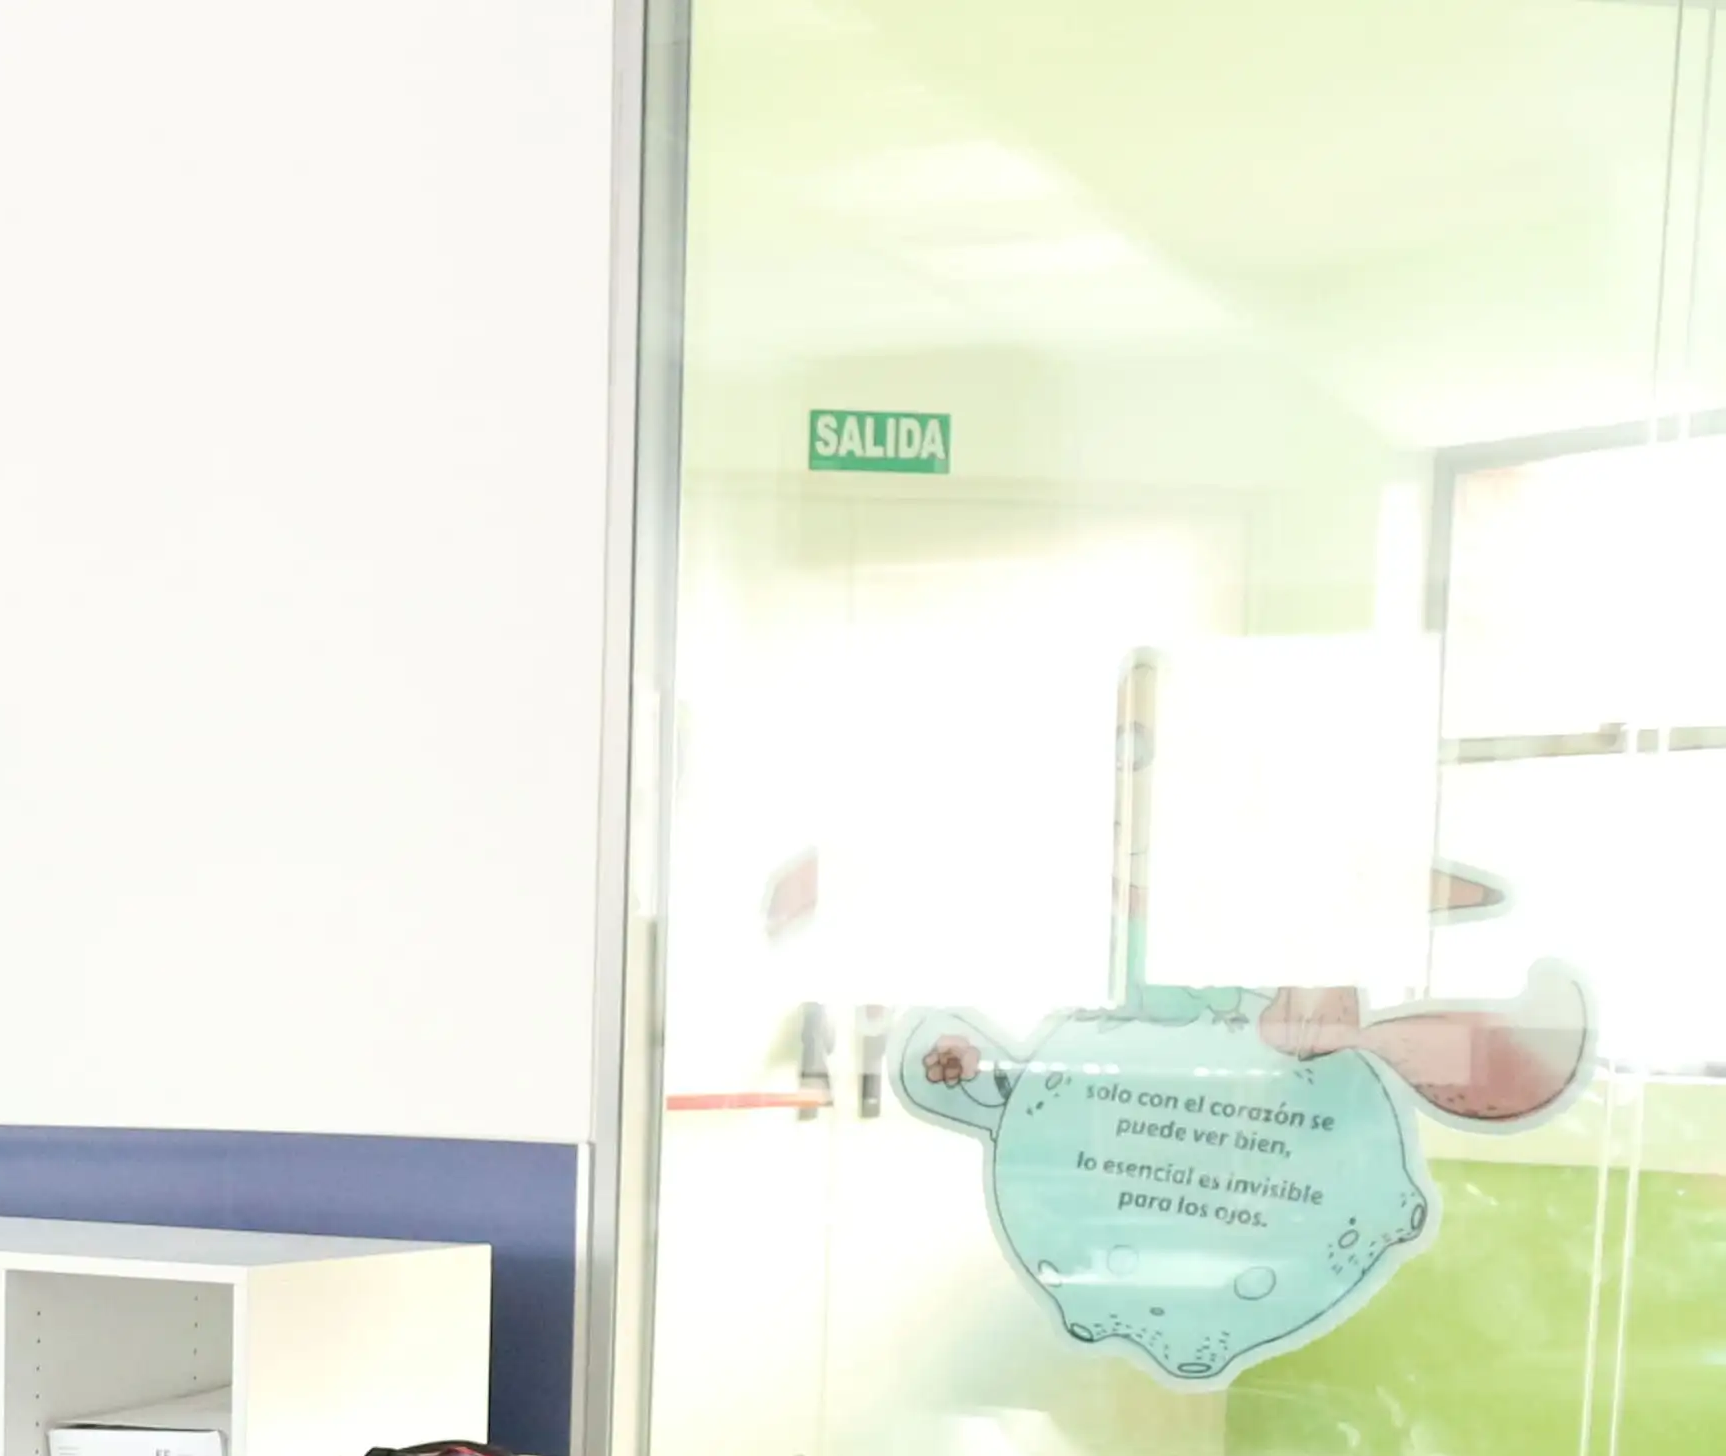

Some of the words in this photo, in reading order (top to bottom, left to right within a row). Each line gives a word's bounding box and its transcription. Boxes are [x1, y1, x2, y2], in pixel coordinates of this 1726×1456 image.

[815, 413, 945, 460] SALIDA
[1086, 1083, 1132, 1102] solo
[1137, 1090, 1178, 1110] con
[1184, 1095, 1205, 1113] el
[1210, 1101, 1305, 1128] corazón
[1310, 1113, 1335, 1131] se
[1116, 1117, 1186, 1142] puede
[1193, 1128, 1230, 1147] ver
[1234, 1130, 1292, 1159] bien,
[1076, 1151, 1097, 1171] lo
[1102, 1158, 1195, 1186] esencial
[1199, 1172, 1220, 1190] es
[1226, 1172, 1324, 1205] invisible
[1118, 1190, 1172, 1212] para
[1177, 1195, 1208, 1217] los
[1214, 1204, 1268, 1228] ojos.
